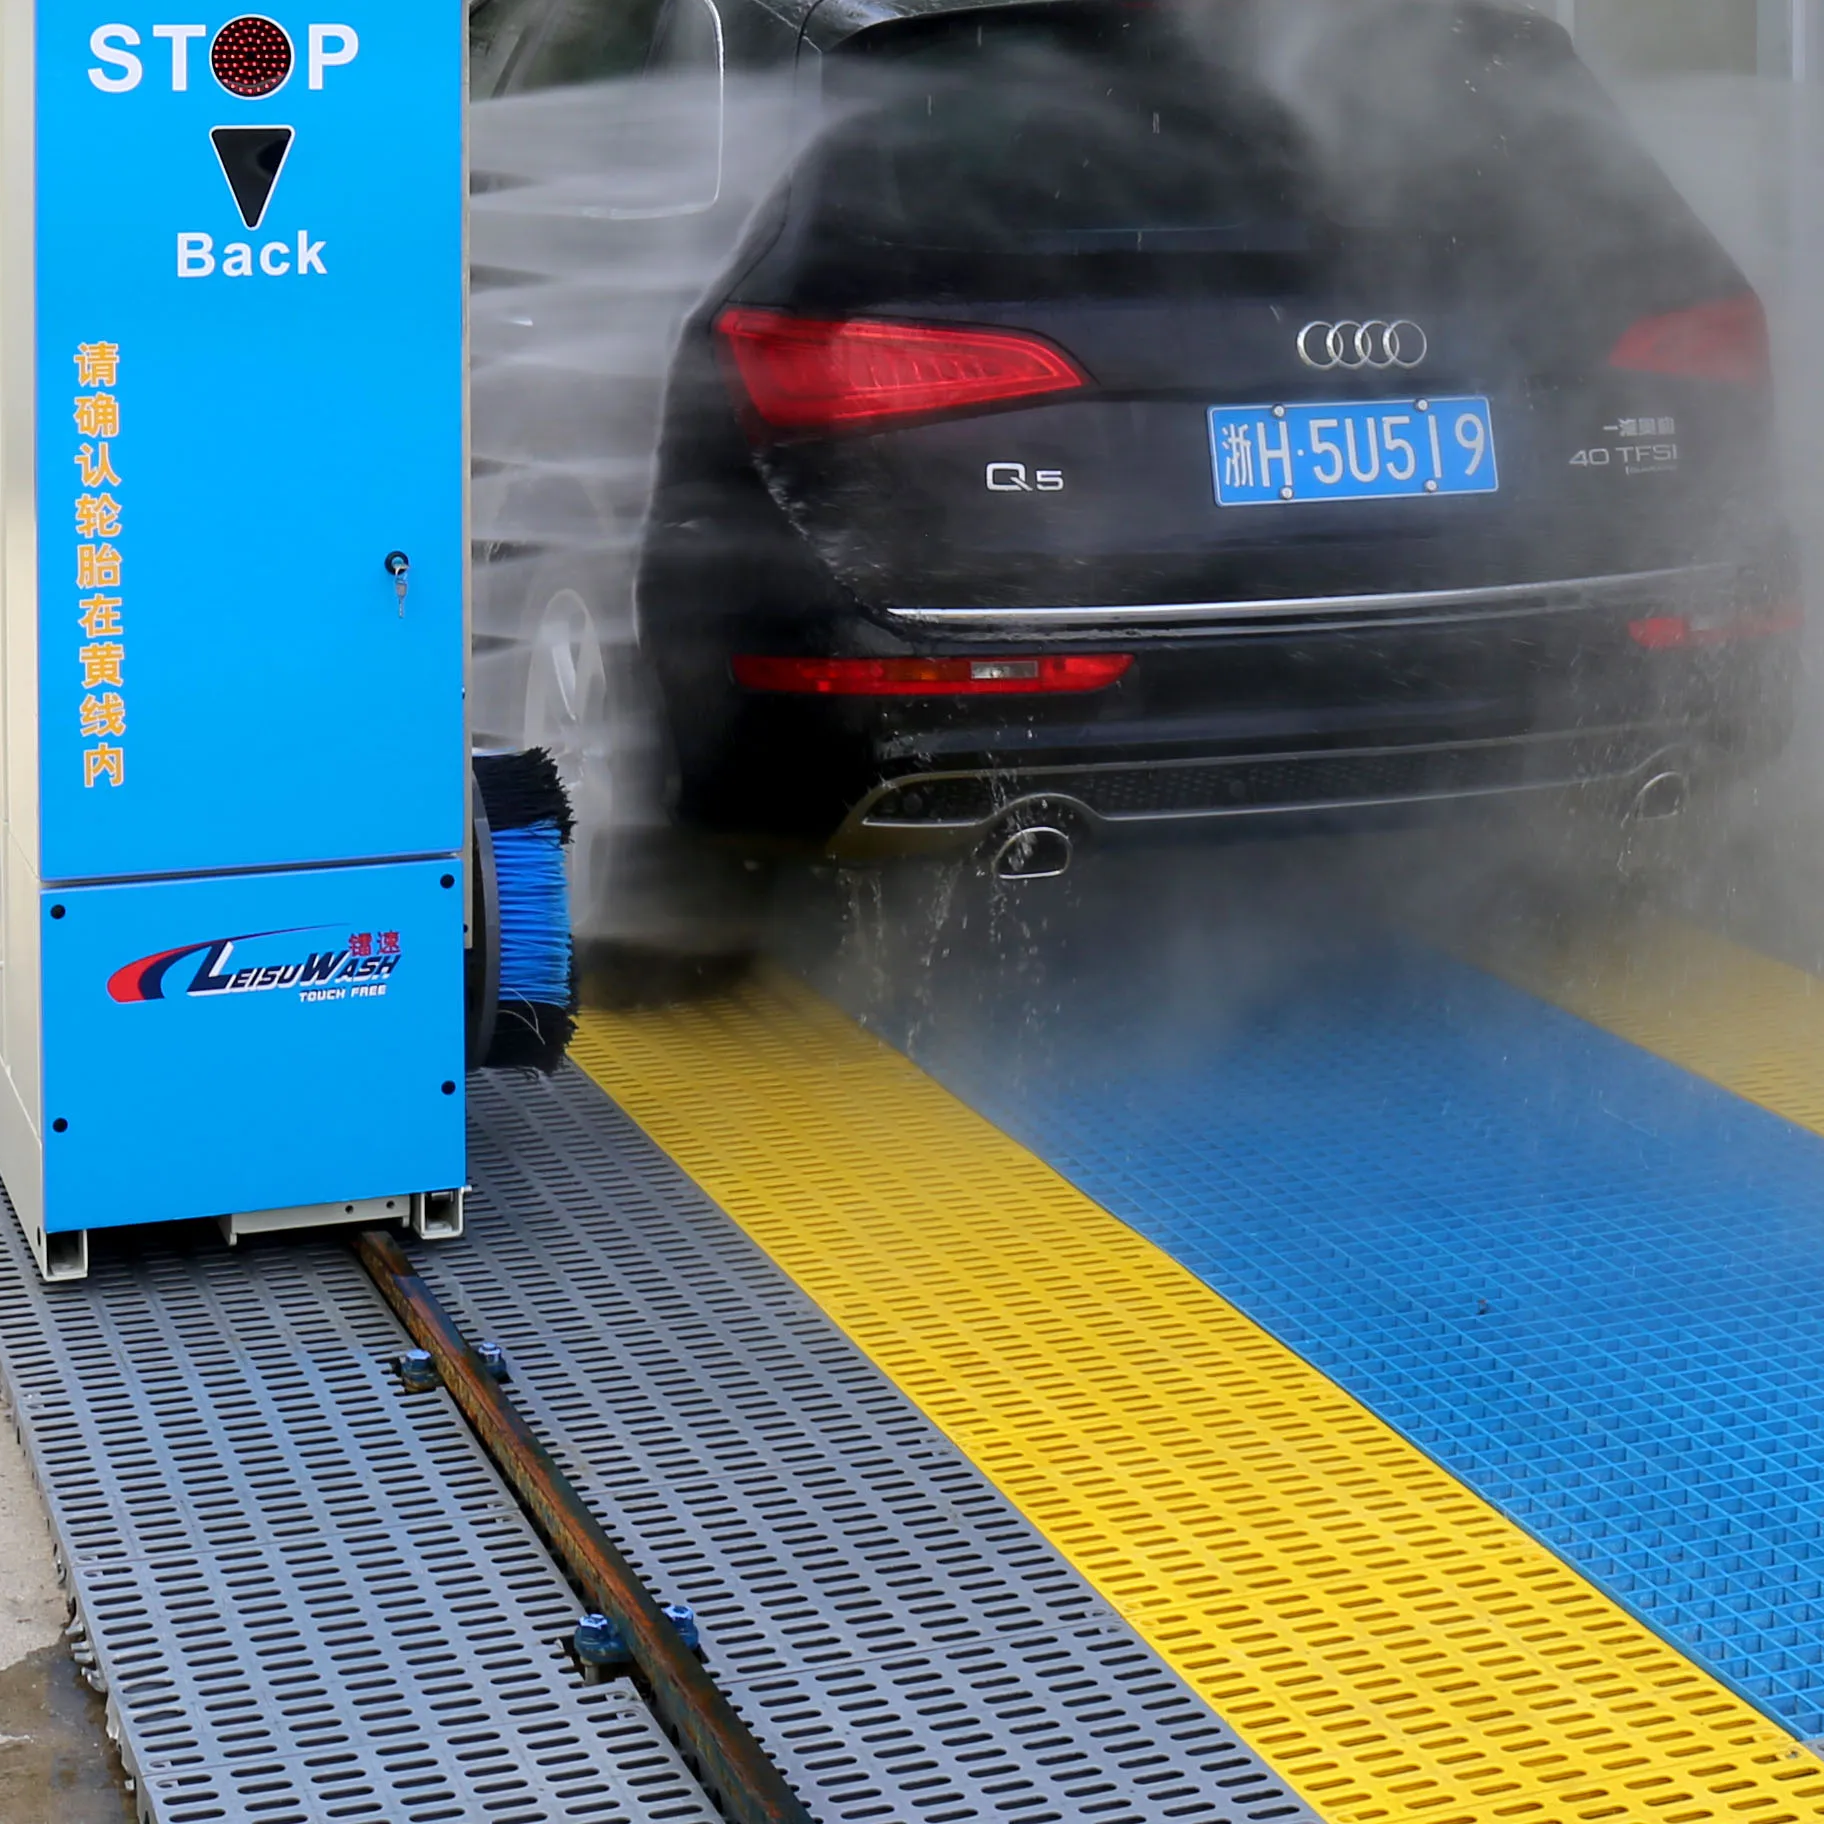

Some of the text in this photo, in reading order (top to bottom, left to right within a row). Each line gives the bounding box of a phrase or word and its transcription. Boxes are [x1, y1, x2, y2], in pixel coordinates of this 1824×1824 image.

[176, 229, 328, 278] Back
[1569, 444, 1678, 467] 40 TFSI
[985, 462, 1065, 493] Q5
[74, 341, 126, 788] 请确认轮胎在黄线内
[299, 984, 387, 1003] TOUCH FREE
